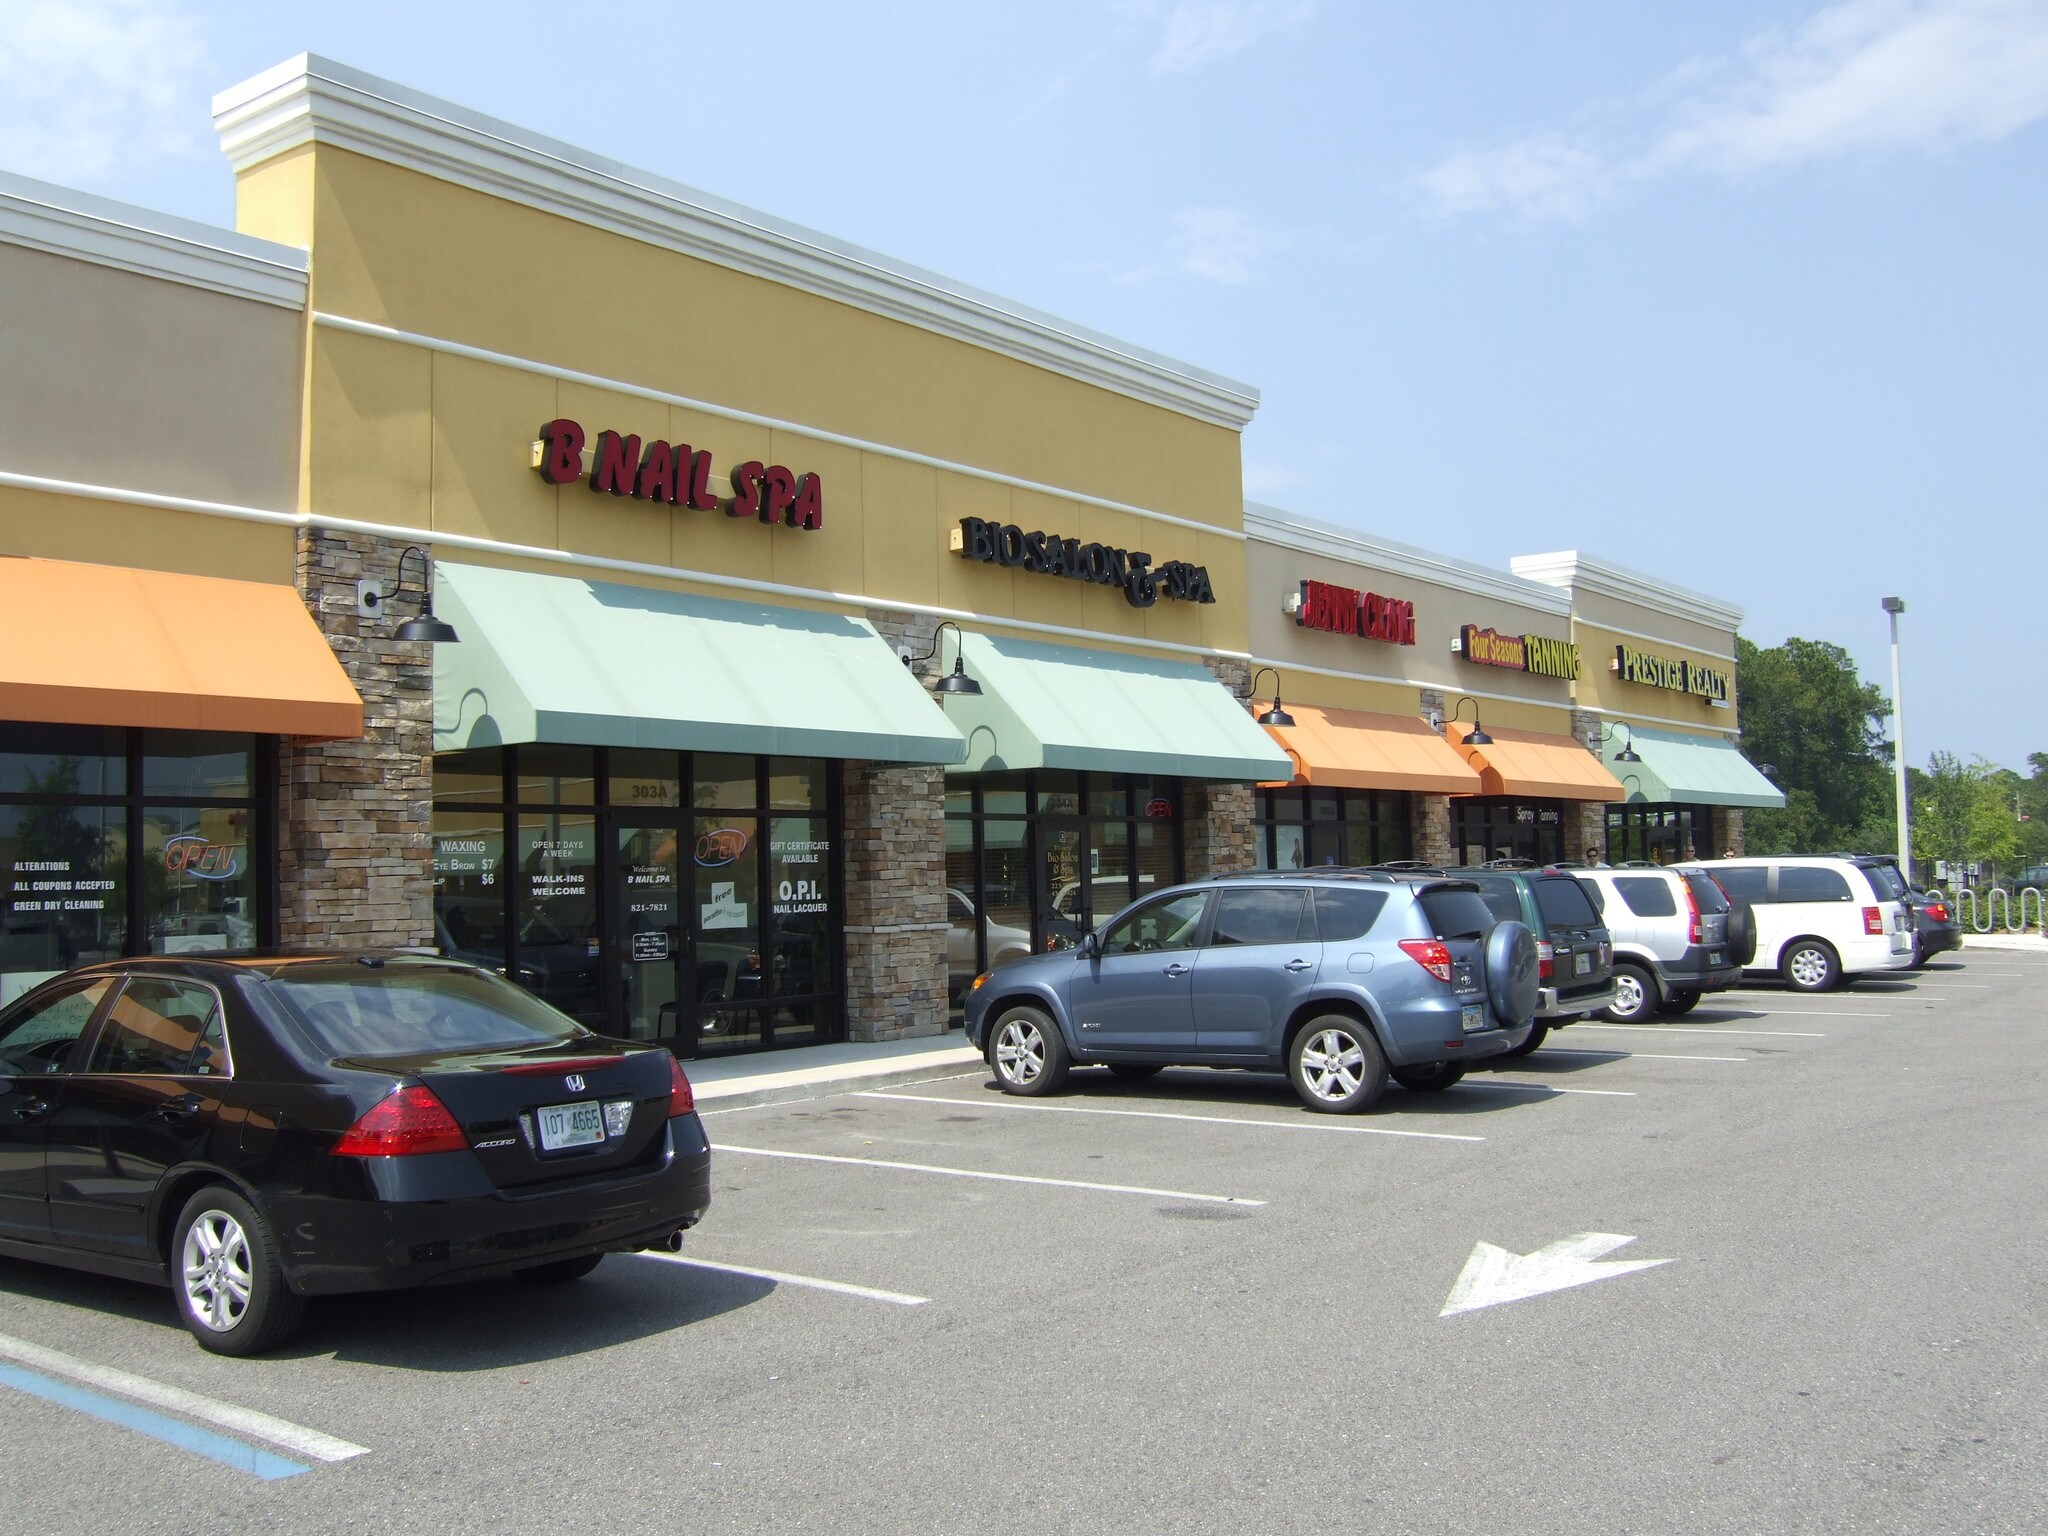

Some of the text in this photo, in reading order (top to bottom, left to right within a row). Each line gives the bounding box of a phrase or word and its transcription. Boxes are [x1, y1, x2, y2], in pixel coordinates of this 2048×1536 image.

[541, 419, 822, 531] B NAIL SPA
[1163, 560, 1216, 604] SPA
[1297, 579, 1415, 645] JENNY CRAIG
[1468, 628, 1580, 680] Four Seasons TANNING
[632, 785, 668, 798] 303A
[1146, 802, 1174, 817] OPEN
[1516, 806, 1558, 824] Spray anning
[441, 841, 486, 852] WAXING
[532, 841, 583, 849] OPEN 7 DAYS
[696, 836, 741, 859] OPEN
[770, 842, 830, 850] GIFT CERTIFICATE
[165, 845, 235, 871] OPEN
[551, 850, 573, 858] WEEK
[782, 854, 819, 863] AVAILABLE
[14, 862, 70, 871] ALTERATIONS
[482, 859, 494, 870] $7
[632, 865, 658, 873] Welcome
[482, 873, 494, 885] $6
[532, 875, 585, 883] WALK-INS
[655, 875, 670, 883] SPA
[14, 881, 115, 891] ALL COUPONS ACCEPTED
[532, 887, 586, 896] WELCOME
[779, 881, 821, 900] O.P.I.
[715, 888, 732, 903] free
[14, 900, 104, 911] GREEN DRY CLEANING
[631, 904, 667, 912] 821-7821
[774, 903, 828, 913] NAIL LACQUER
[544, 1109, 600, 1135] 107 4665
[473, 1139, 516, 1149] ACCORD
